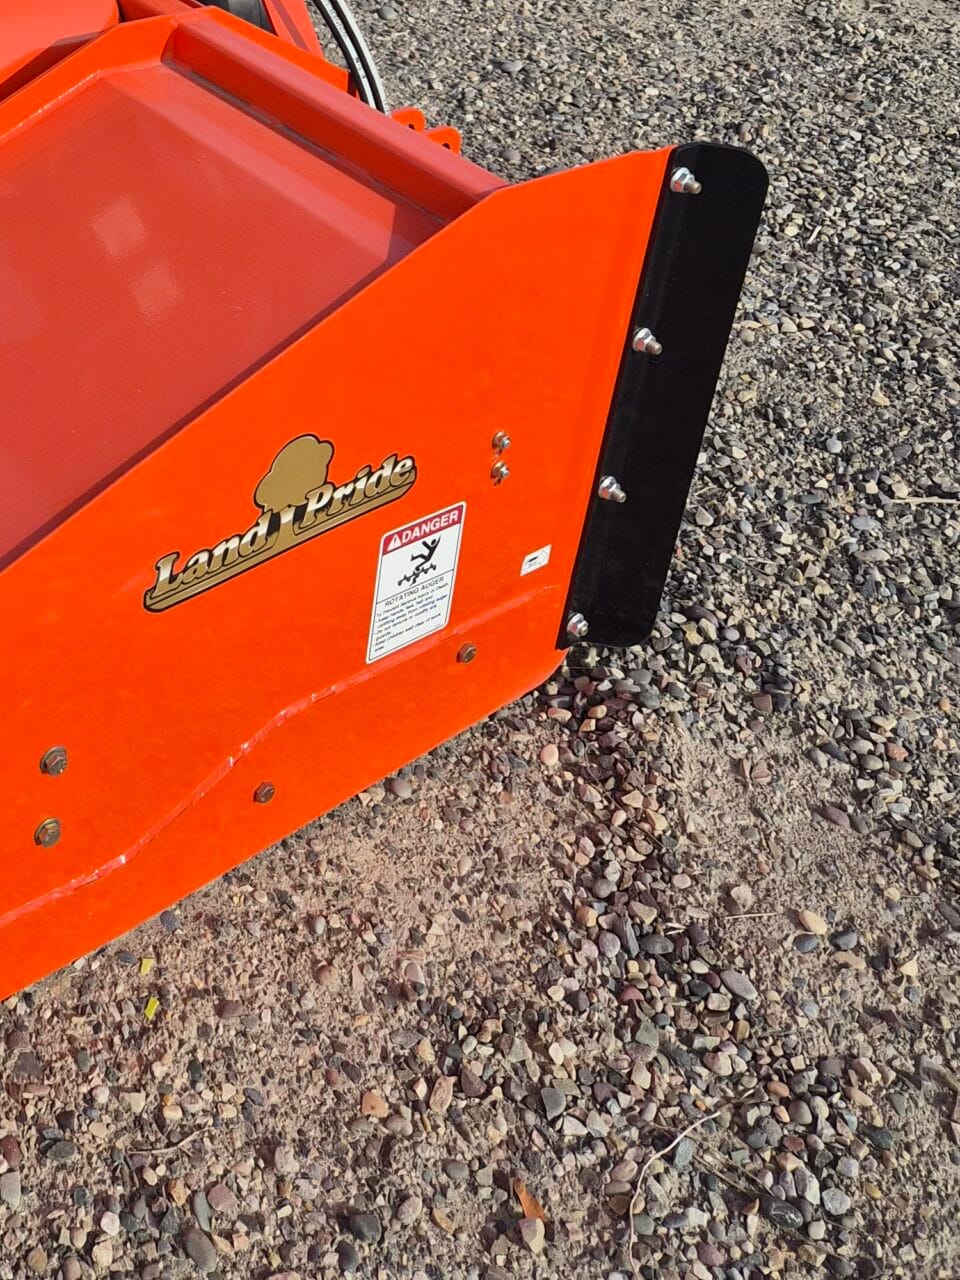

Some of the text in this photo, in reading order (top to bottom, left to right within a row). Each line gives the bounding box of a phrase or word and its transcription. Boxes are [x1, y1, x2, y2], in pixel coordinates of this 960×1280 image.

[148, 453, 417, 600] Land Pride
[402, 511, 459, 543] DANGER
[384, 577, 444, 606] ROTATING AUGER
